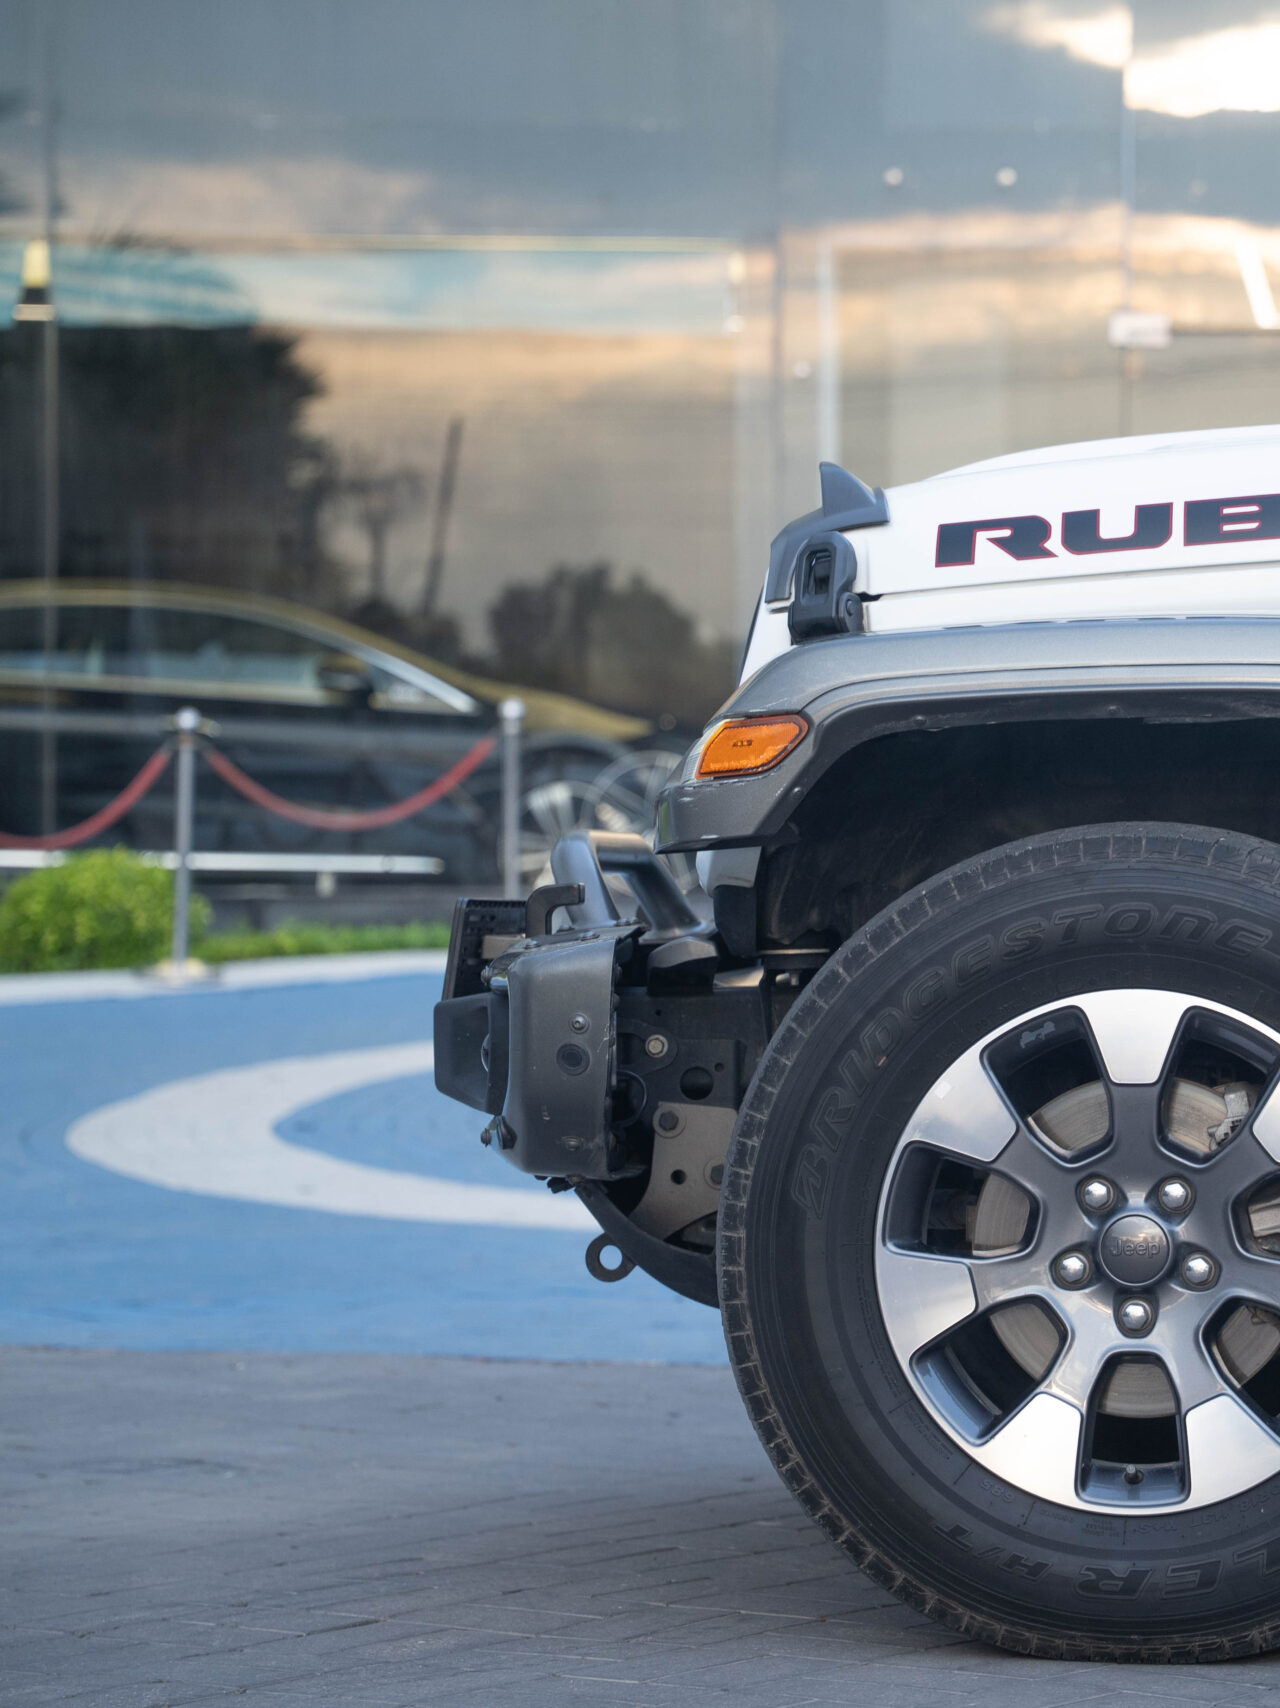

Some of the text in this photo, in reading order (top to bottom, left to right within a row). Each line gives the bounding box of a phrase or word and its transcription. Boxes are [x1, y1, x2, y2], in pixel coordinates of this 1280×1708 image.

[790, 902, 1271, 1219] BRIDGESTONE
[1110, 1238, 1161, 1259] Jeep
[930, 1514, 1053, 1582] H/T
